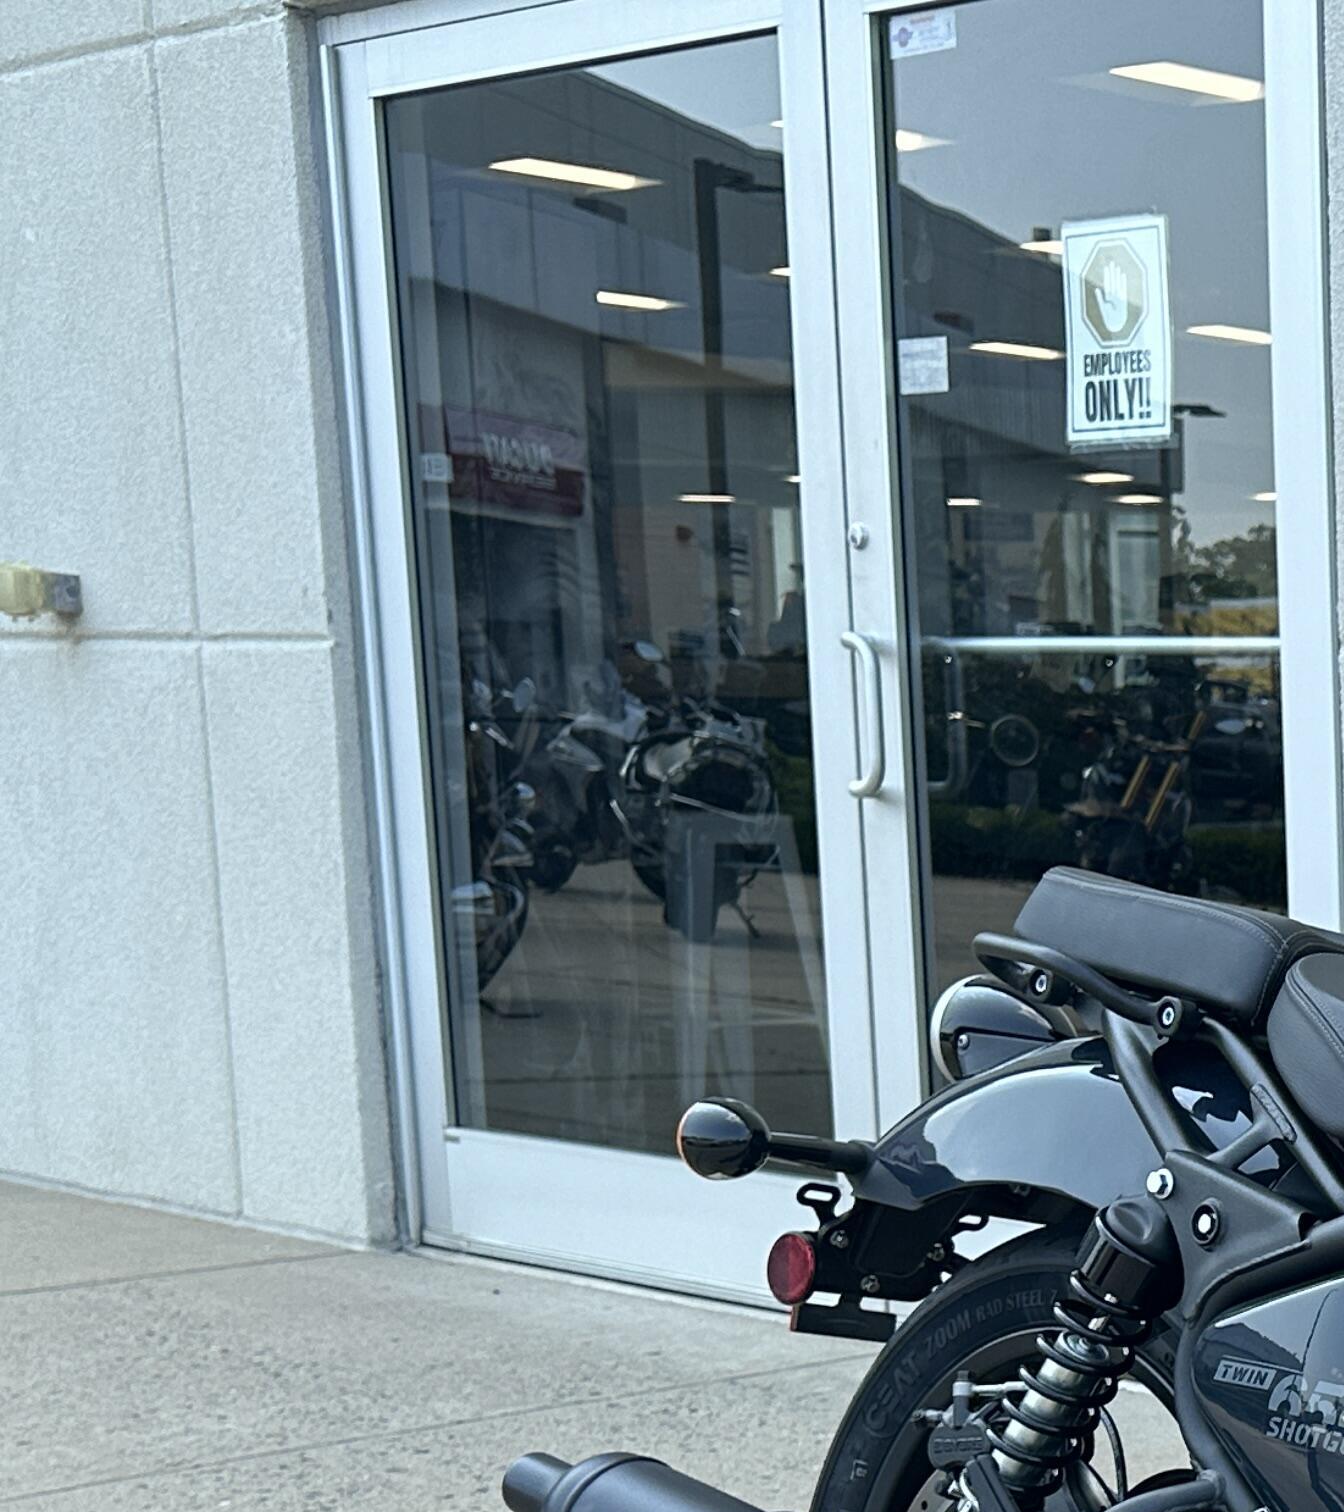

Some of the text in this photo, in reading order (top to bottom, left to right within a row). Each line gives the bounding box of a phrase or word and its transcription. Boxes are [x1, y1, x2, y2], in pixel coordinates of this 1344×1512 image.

[1083, 350, 1151, 377] EMPLOYEES
[1085, 377, 1152, 422] ONLY!!
[925, 1308, 973, 1358] ZOOM
[976, 1298, 1004, 1323] RAD
[1005, 1289, 1046, 1310] STEEL
[1221, 1364, 1270, 1386] TWIN
